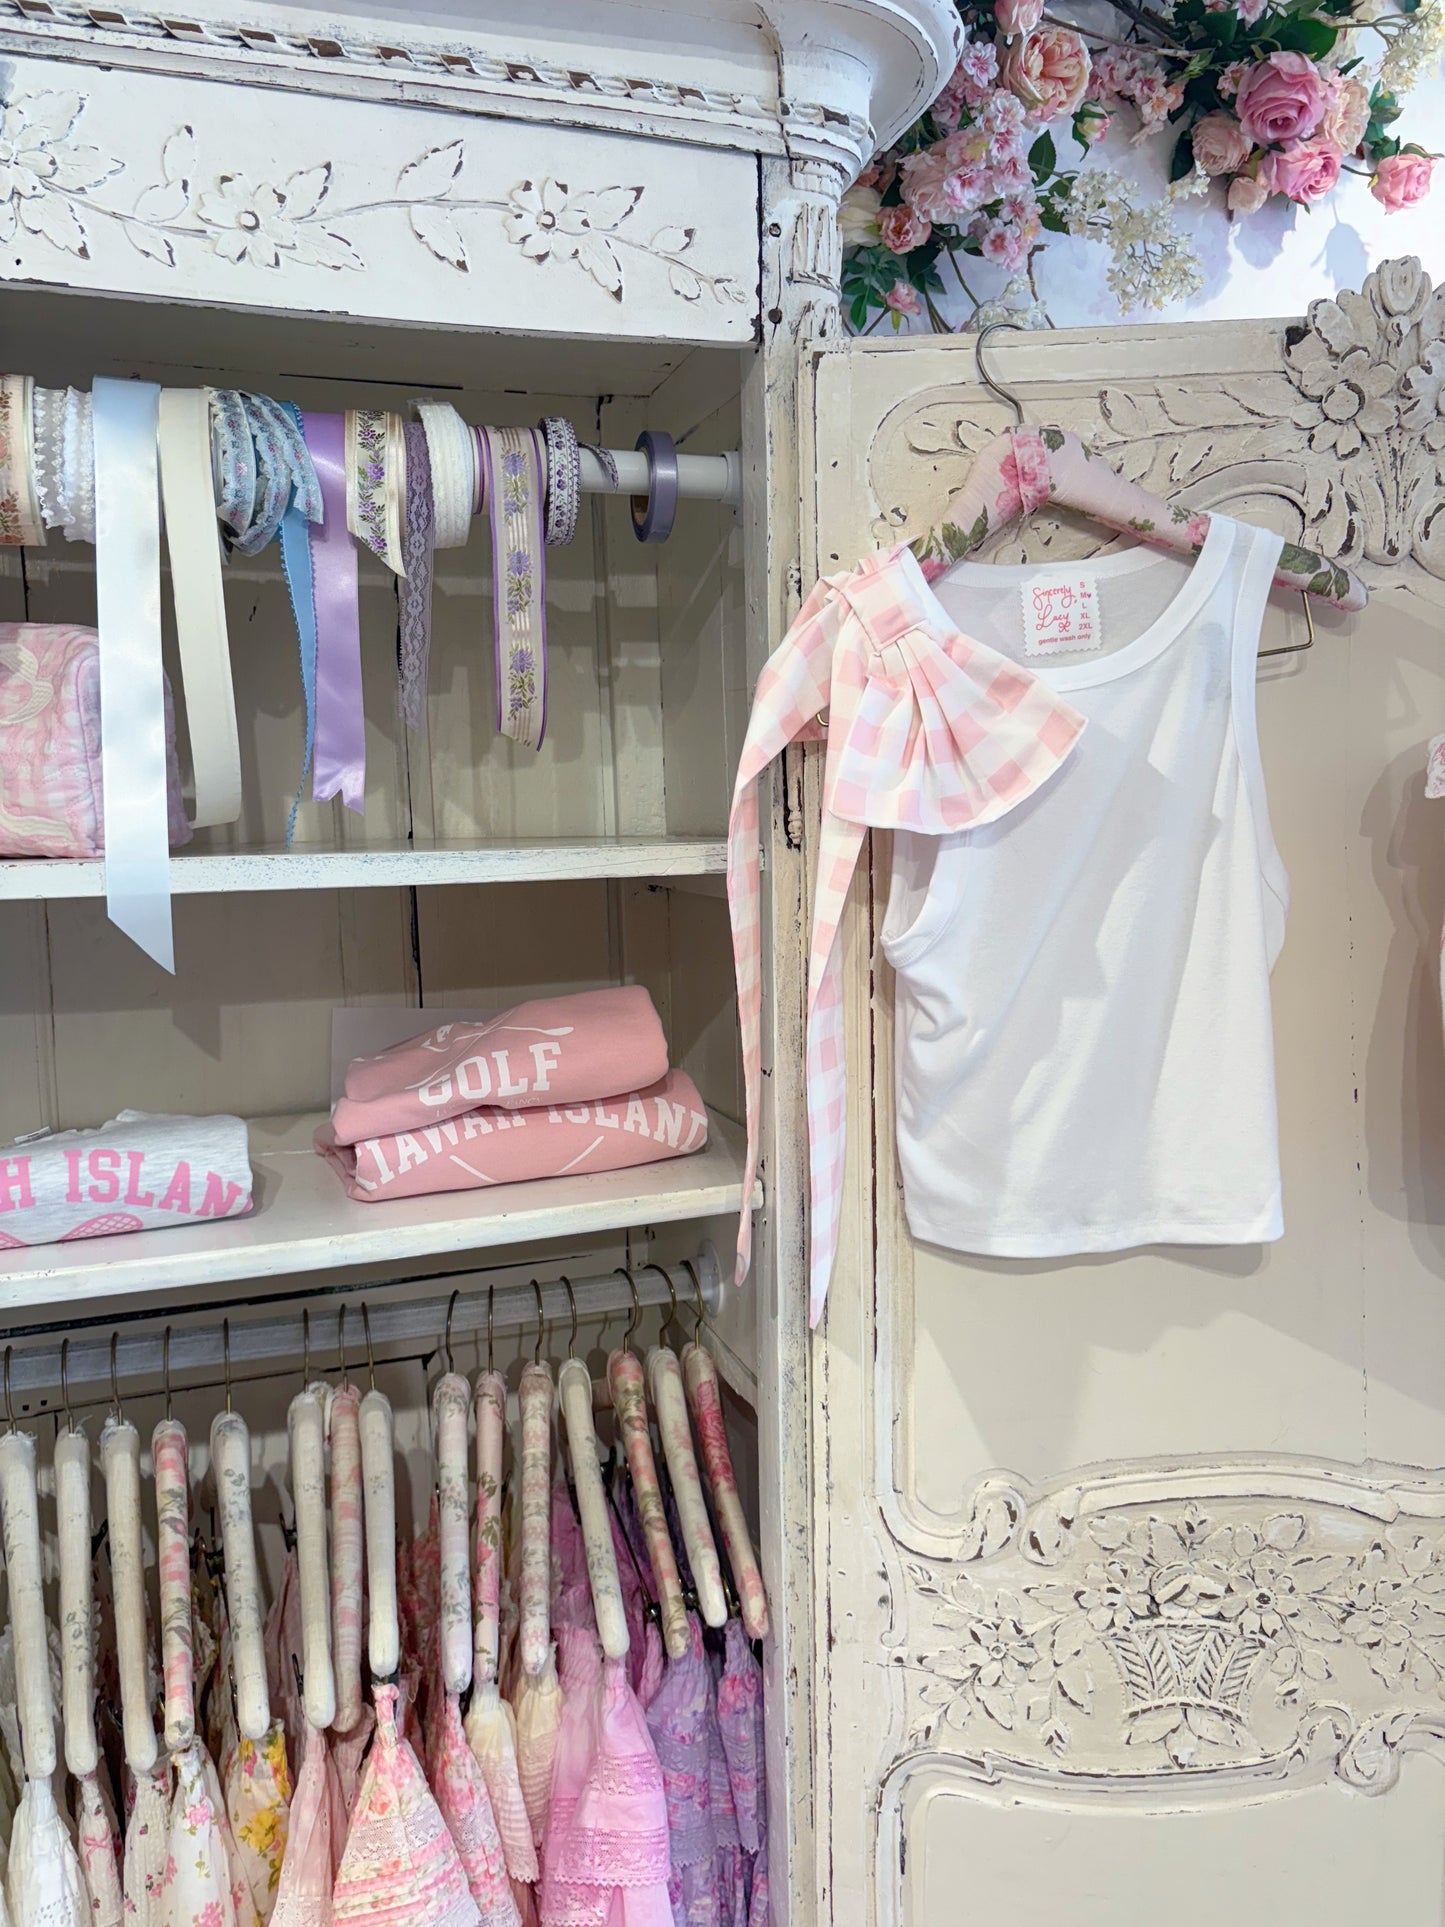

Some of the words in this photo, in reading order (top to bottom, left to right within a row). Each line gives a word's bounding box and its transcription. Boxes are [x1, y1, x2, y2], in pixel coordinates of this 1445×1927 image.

[1036, 604, 1070, 631] Lacy
[1038, 637, 1058, 645] gentle
[1060, 634, 1076, 642] wash
[418, 1041, 562, 1106] GOLF
[64, 1148, 253, 1217] ISLAN
